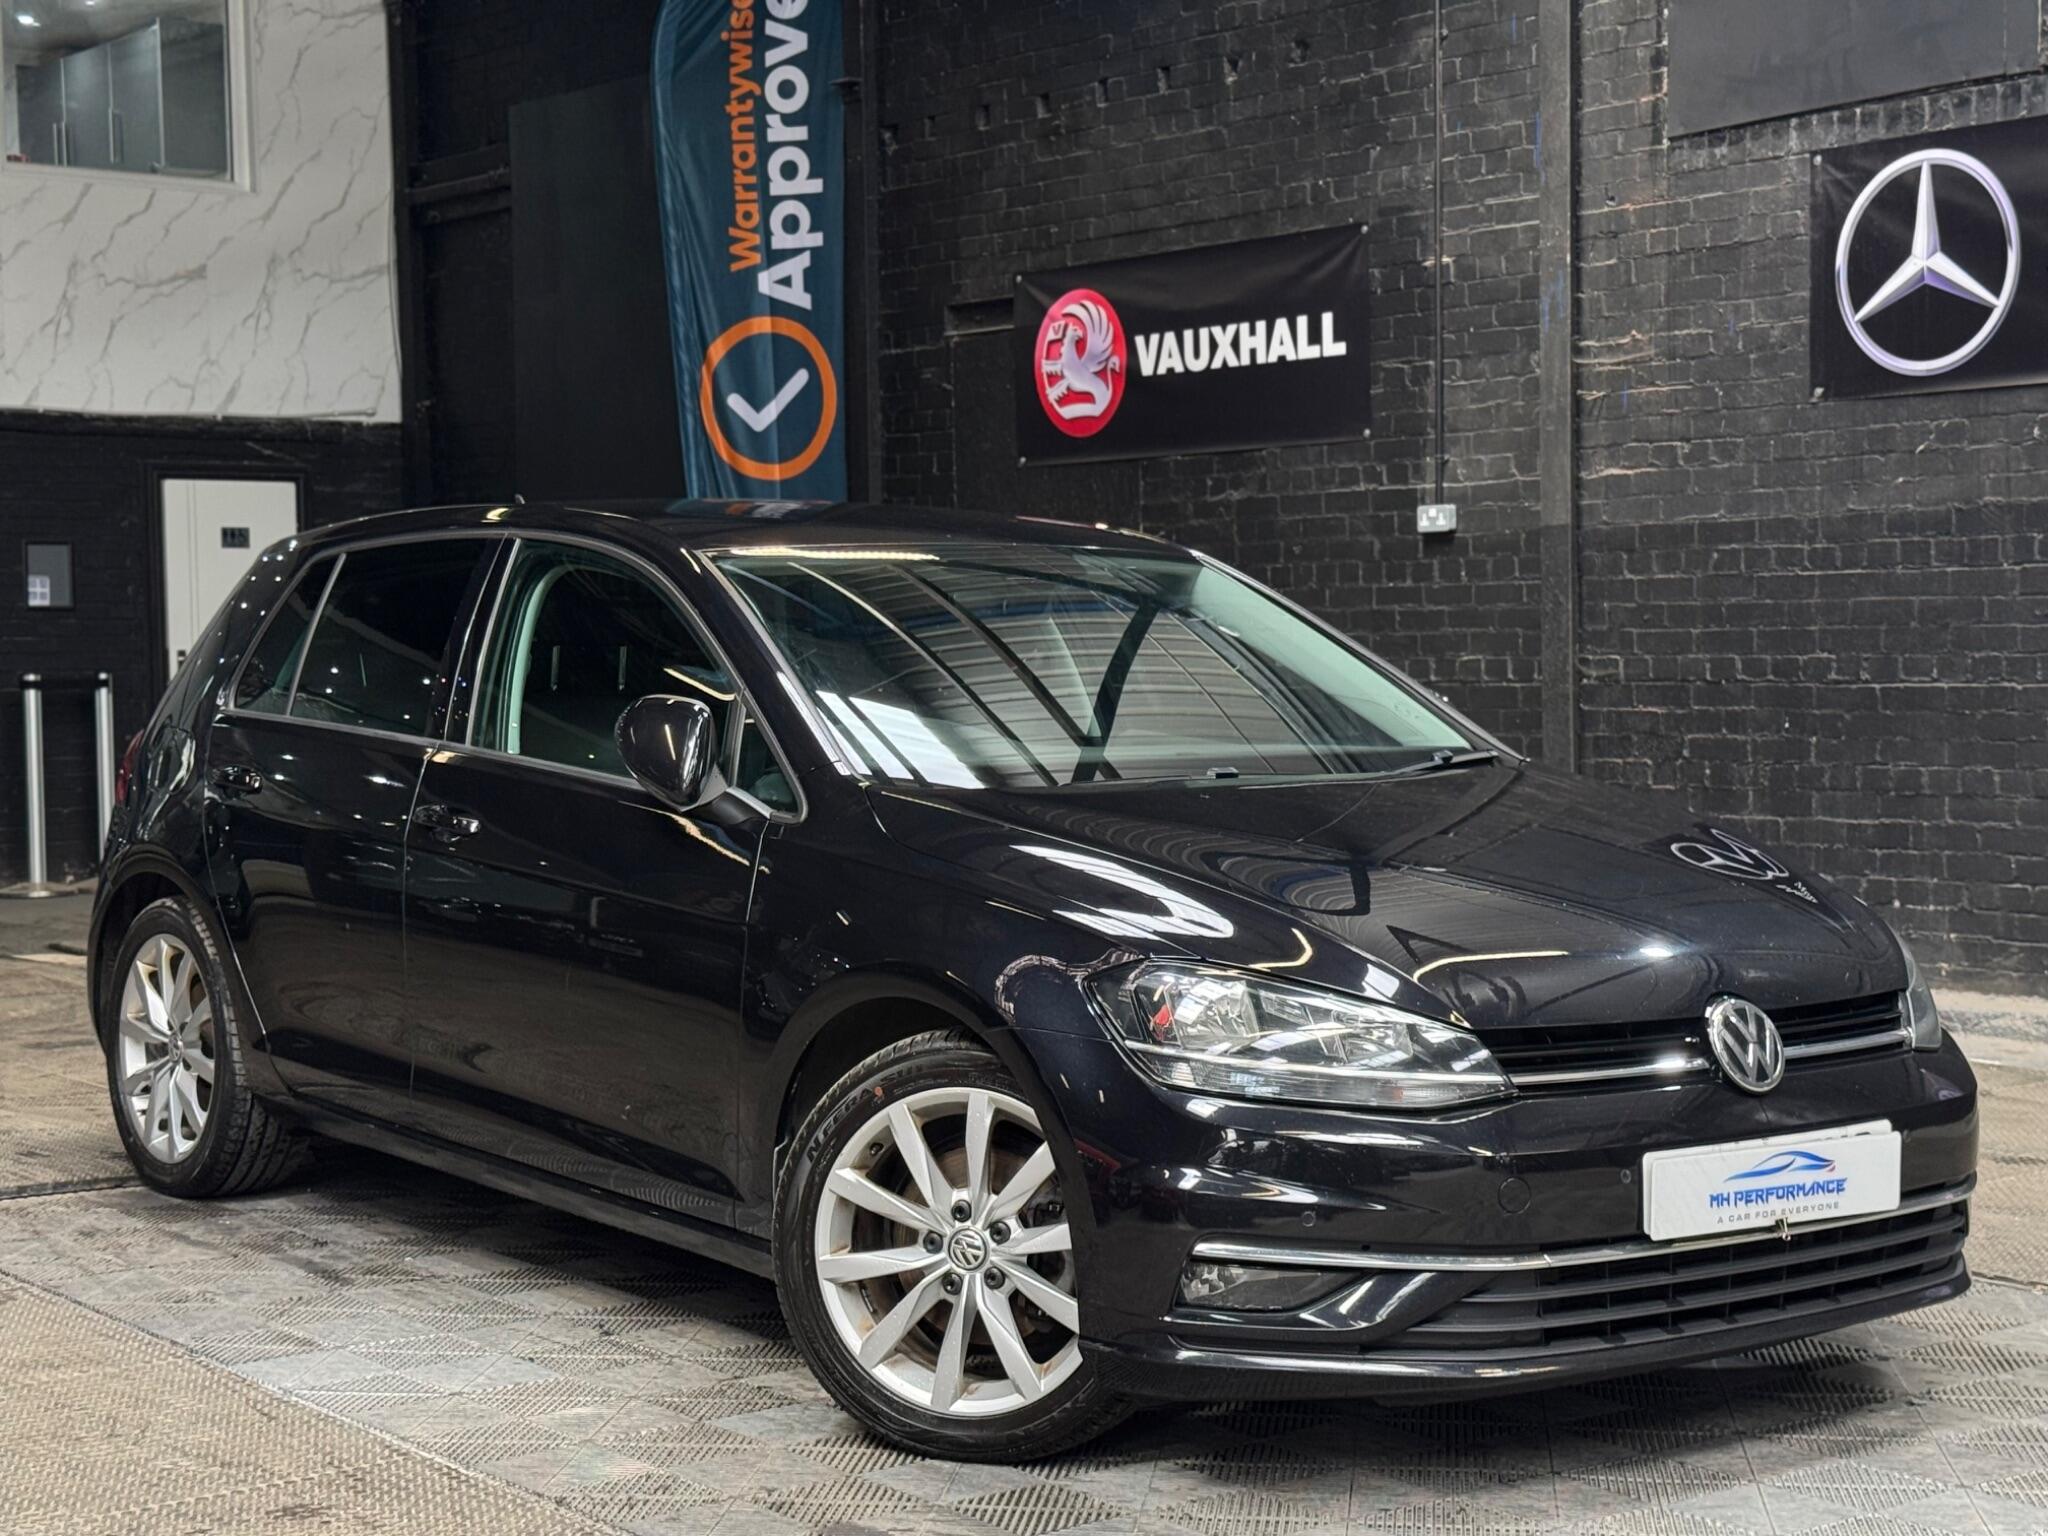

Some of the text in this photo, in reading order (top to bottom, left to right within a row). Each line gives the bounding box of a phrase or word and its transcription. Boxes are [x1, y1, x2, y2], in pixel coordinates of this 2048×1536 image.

[1134, 311, 1347, 377] VAUXHALL
[1711, 999, 1785, 1092] VW
[1709, 1177, 1848, 1209] MH PERFORMANCE
[1717, 1201, 1840, 1224] A CAR FOR EVERYONE
